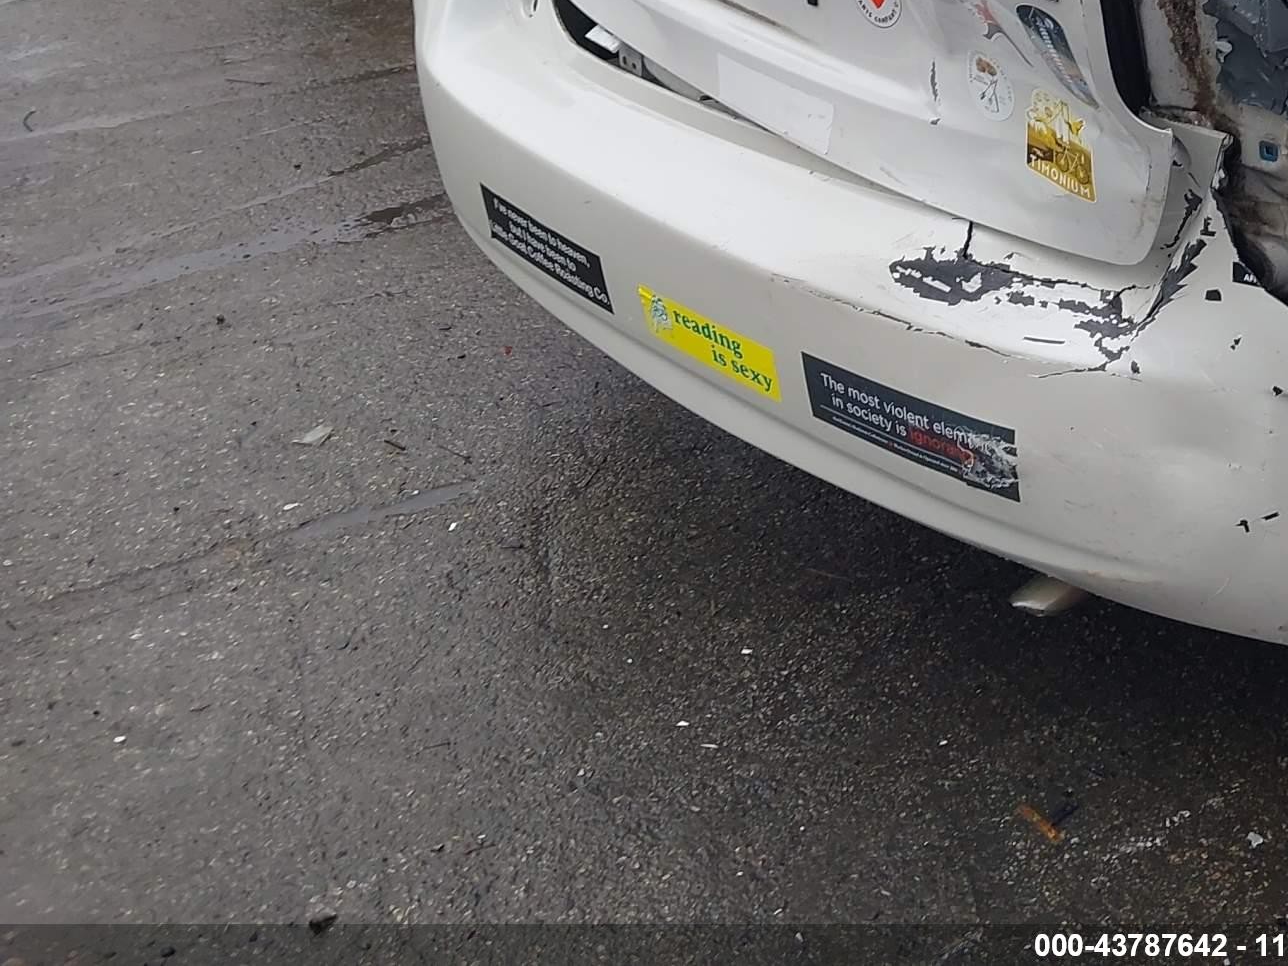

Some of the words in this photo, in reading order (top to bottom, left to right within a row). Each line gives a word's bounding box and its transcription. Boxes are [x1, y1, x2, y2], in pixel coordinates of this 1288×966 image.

[1029, 154, 1091, 199] TIMONIUM
[526, 232, 546, 253] have
[554, 263, 595, 298] Roasting
[673, 310, 743, 359] reading
[711, 344, 727, 366] is
[731, 359, 772, 392] sexy
[820, 372, 845, 394] The
[847, 387, 881, 410] most
[883, 401, 930, 430] violent
[831, 393, 844, 410] in
[846, 402, 893, 432] society
[895, 420, 907, 437] is
